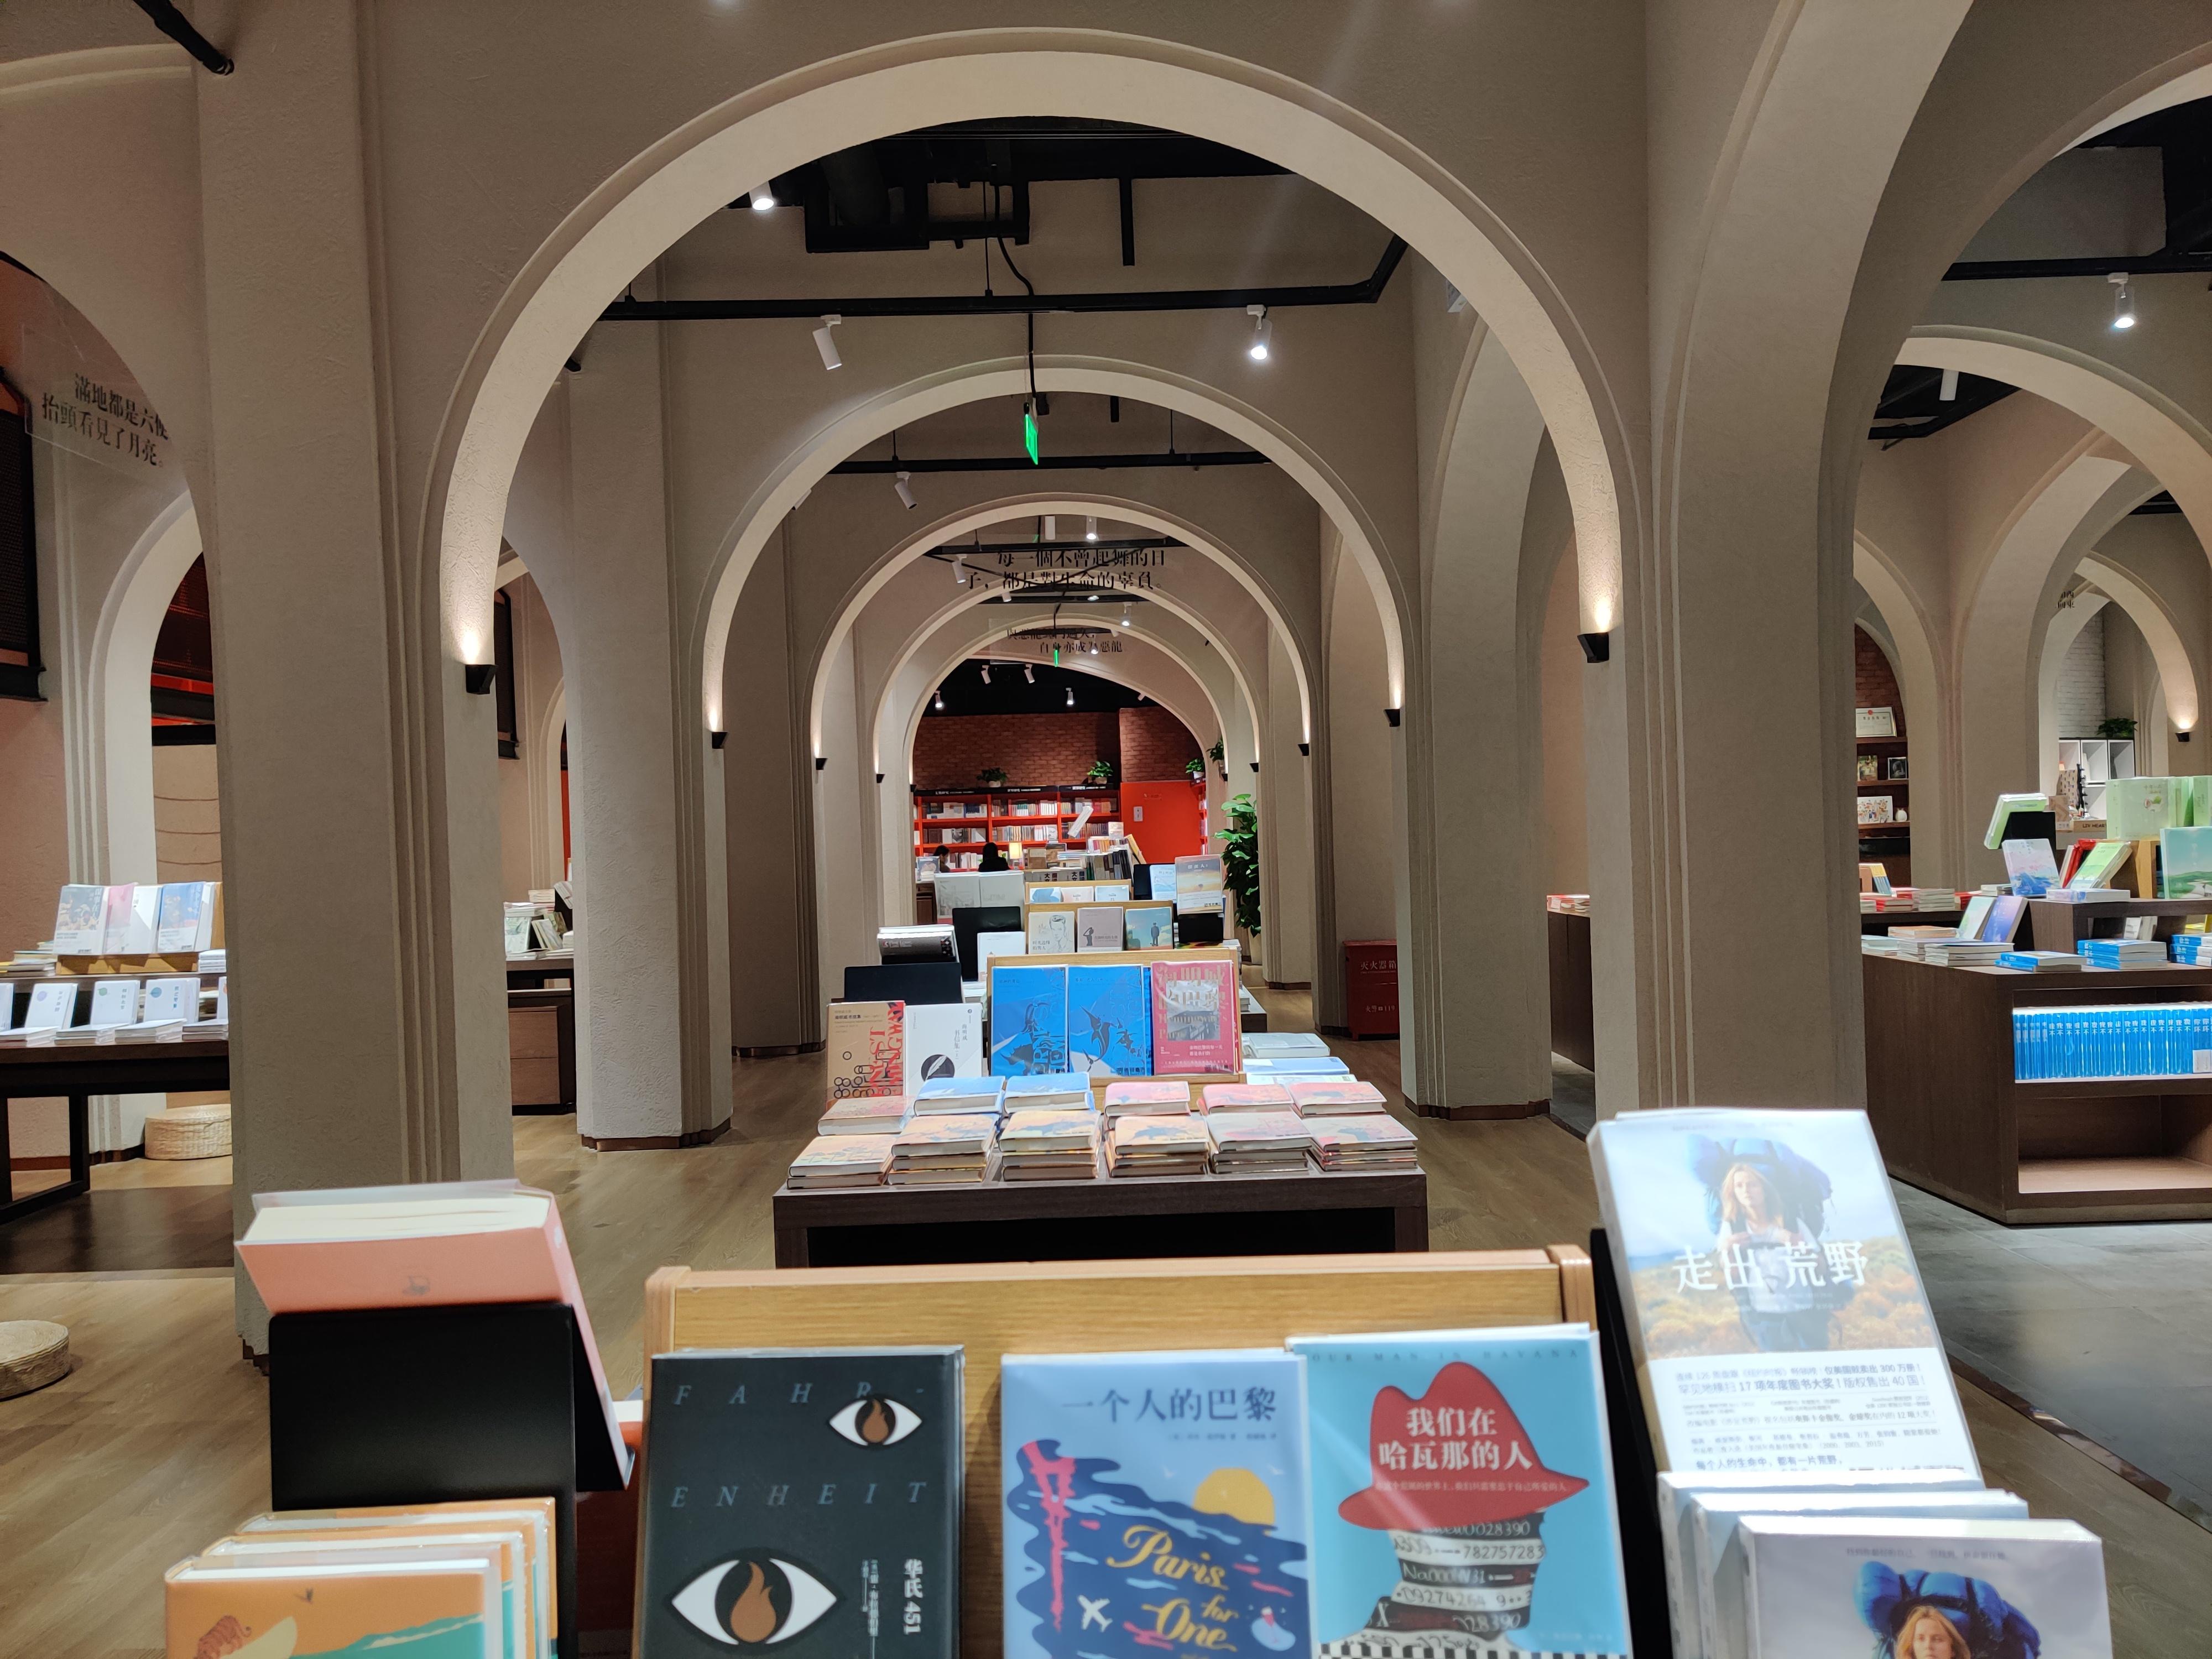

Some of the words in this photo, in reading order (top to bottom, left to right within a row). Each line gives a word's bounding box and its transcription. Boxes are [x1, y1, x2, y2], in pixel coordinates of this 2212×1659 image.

[1672, 1241, 1867, 1293] 走出荒野
[1061, 1386, 1277, 1423] 一个人的巴黎
[1406, 1407, 1498, 1438] 我们在
[1378, 1441, 1533, 1471] 哈瓦那的人
[670, 1481, 926, 1508] ENHEIT
[1106, 1524, 1229, 1590] Paris
[1141, 1598, 1238, 1652] One
[1202, 1595, 1238, 1623] for
